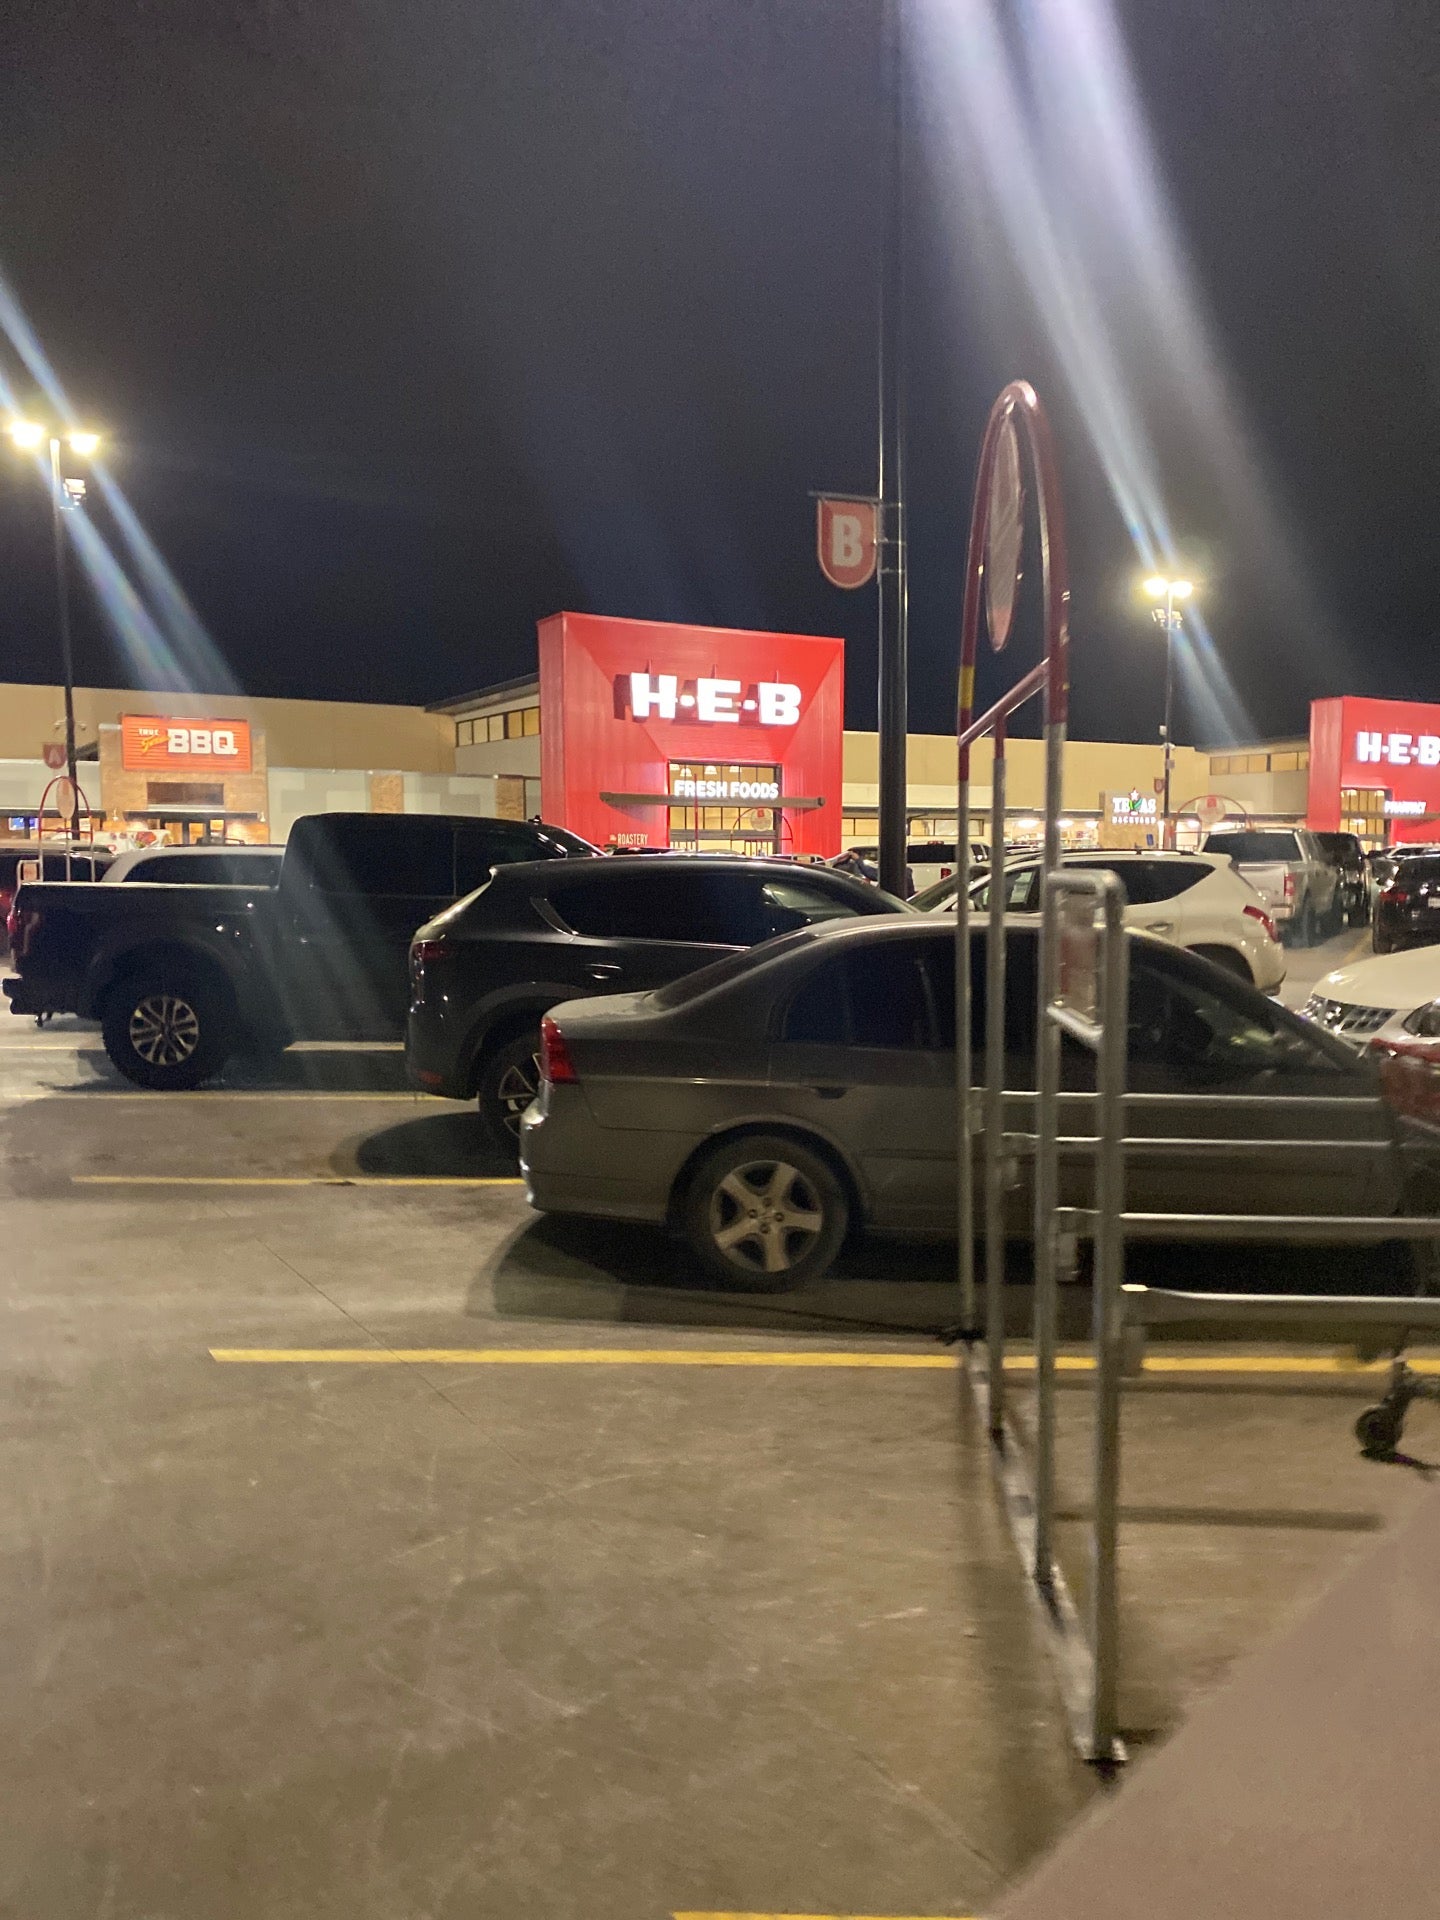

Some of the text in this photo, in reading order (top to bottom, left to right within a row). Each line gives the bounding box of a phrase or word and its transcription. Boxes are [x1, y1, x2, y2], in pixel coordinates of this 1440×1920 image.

[832, 514, 863, 567] B
[167, 728, 239, 755] BBQ
[674, 780, 779, 799] FRESH FOODS
[617, 833, 649, 846] ROASTERY
